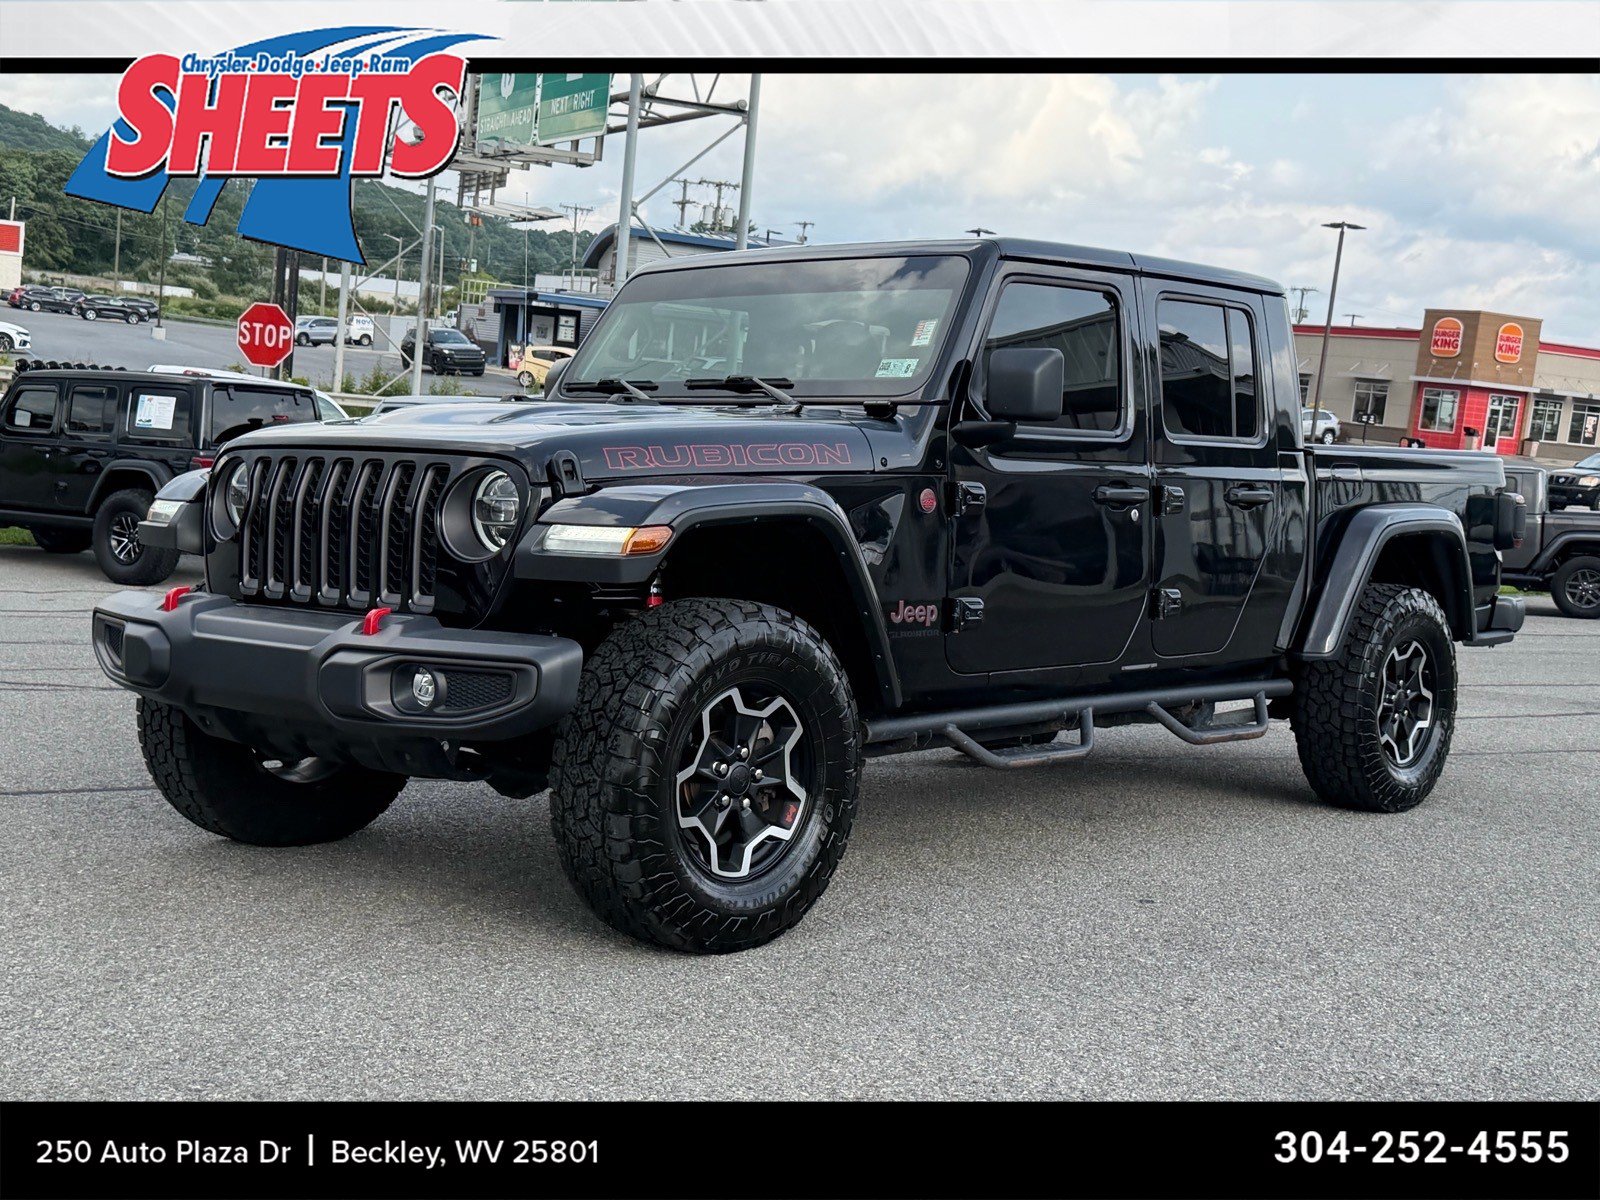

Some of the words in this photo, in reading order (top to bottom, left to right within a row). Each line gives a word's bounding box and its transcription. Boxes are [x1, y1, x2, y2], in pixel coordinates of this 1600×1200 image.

[551, 96, 569, 115] NEXT
[573, 90, 595, 109] RIGHT
[480, 113, 507, 134] STRAIGHT
[511, 108, 532, 126] AHEAD
[239, 321, 291, 348] STOP
[1434, 329, 1460, 338] BURGER
[1500, 335, 1521, 344] BURGER
[1432, 338, 1459, 349] KING
[1497, 344, 1520, 355] KING
[603, 444, 851, 469] RUBICON
[891, 600, 938, 626] Jeep
[889, 629, 940, 639] GLADIATOR
